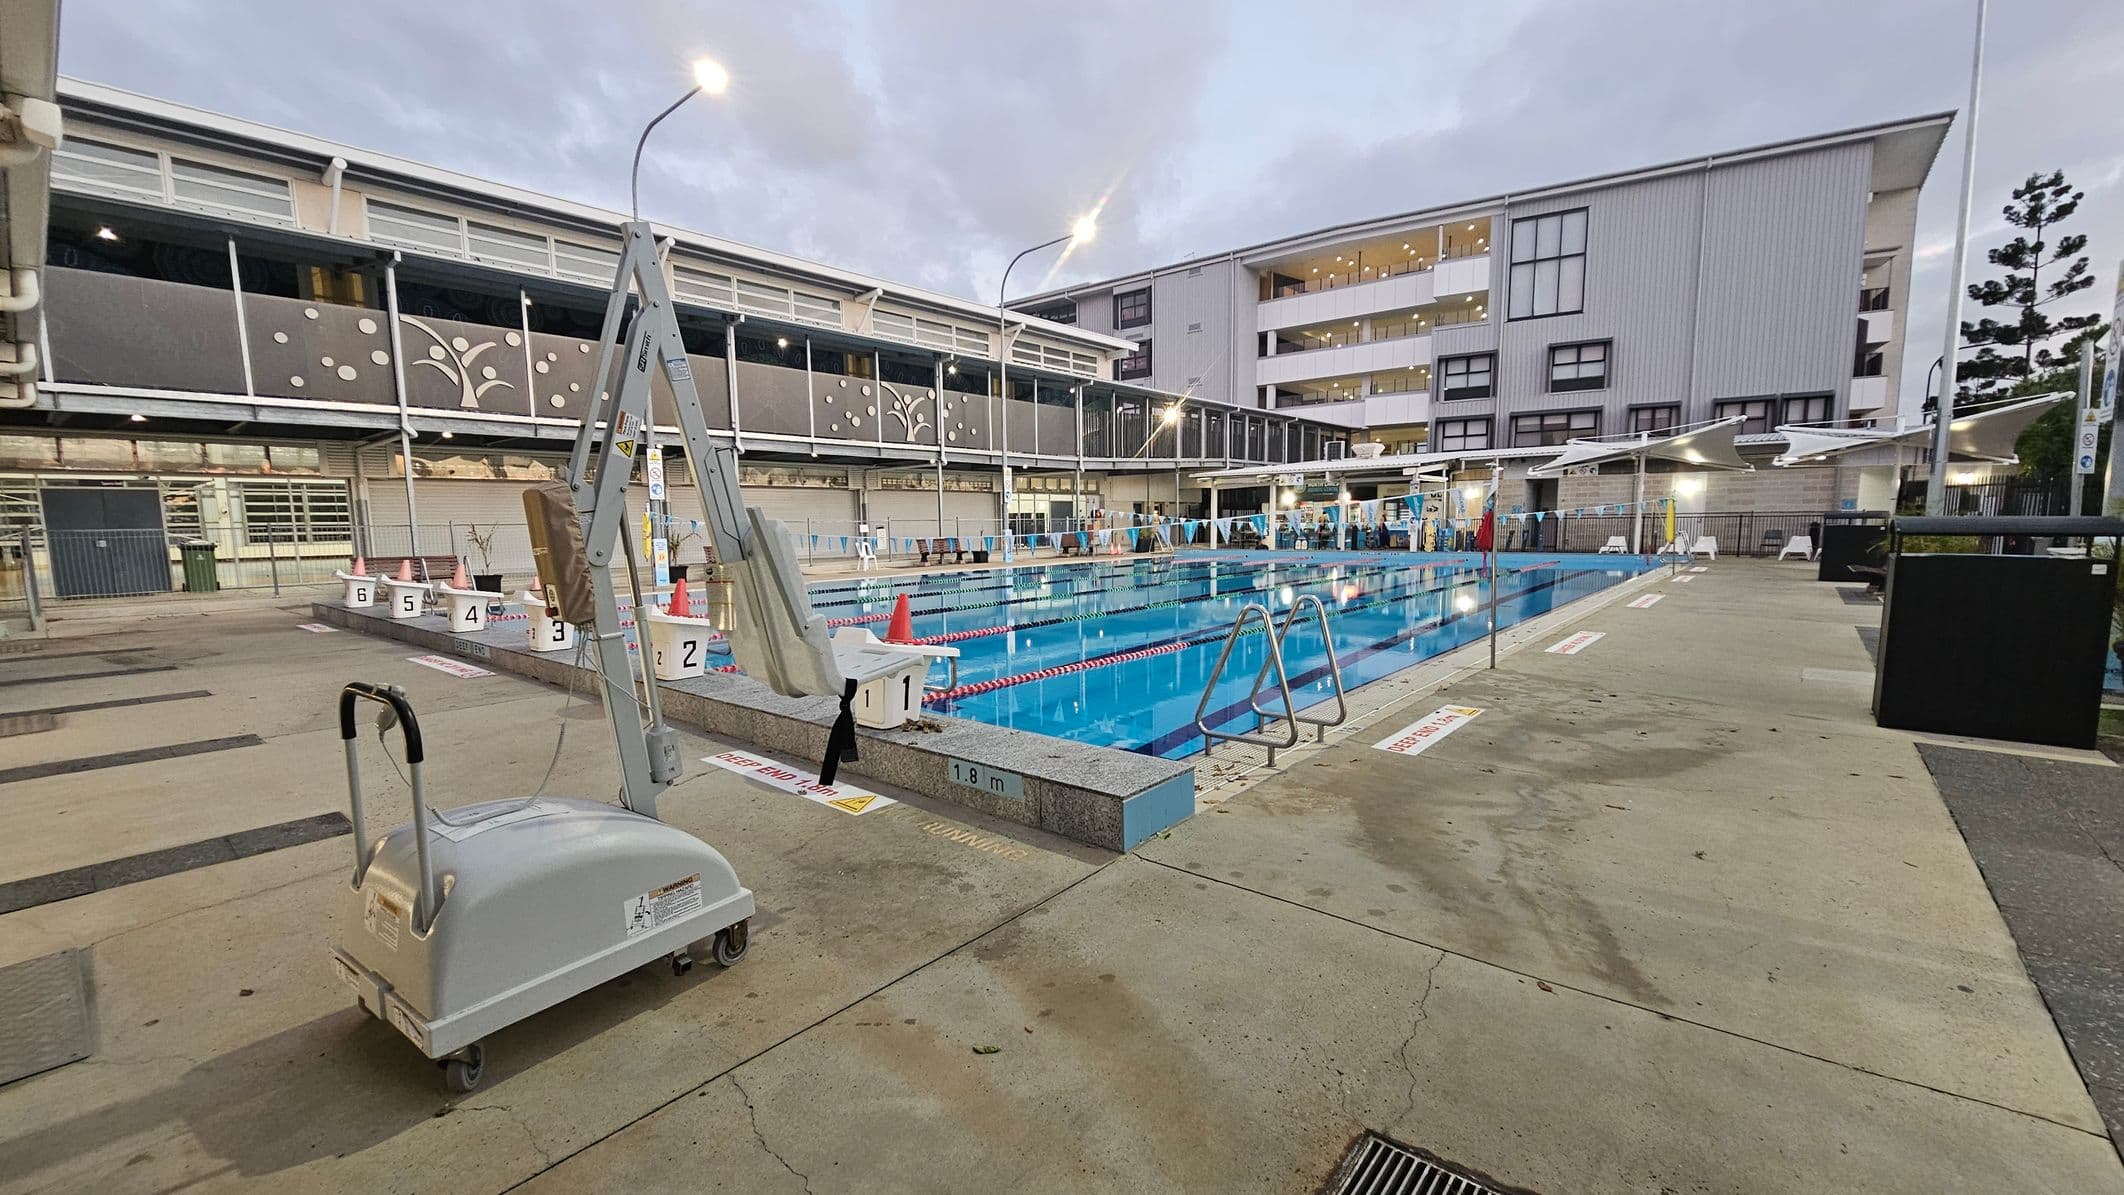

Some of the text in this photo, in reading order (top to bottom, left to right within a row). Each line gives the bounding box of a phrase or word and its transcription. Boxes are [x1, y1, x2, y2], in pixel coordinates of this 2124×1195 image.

[357, 588, 367, 601] 6
[404, 595, 414, 611] 5
[465, 605, 479, 623] 4
[552, 620, 565, 641] 3
[657, 651, 662, 665] 2
[683, 640, 697, 668] 2
[865, 689, 870, 708] 1
[903, 675, 911, 711] 1
[1386, 736, 1420, 752] DEEP
[1413, 724, 1440, 739] END
[716, 753, 839, 797] DEEP END 1.8m
[954, 764, 1004, 793] 1.8 m
[663, 876, 693, 893] WARNING
